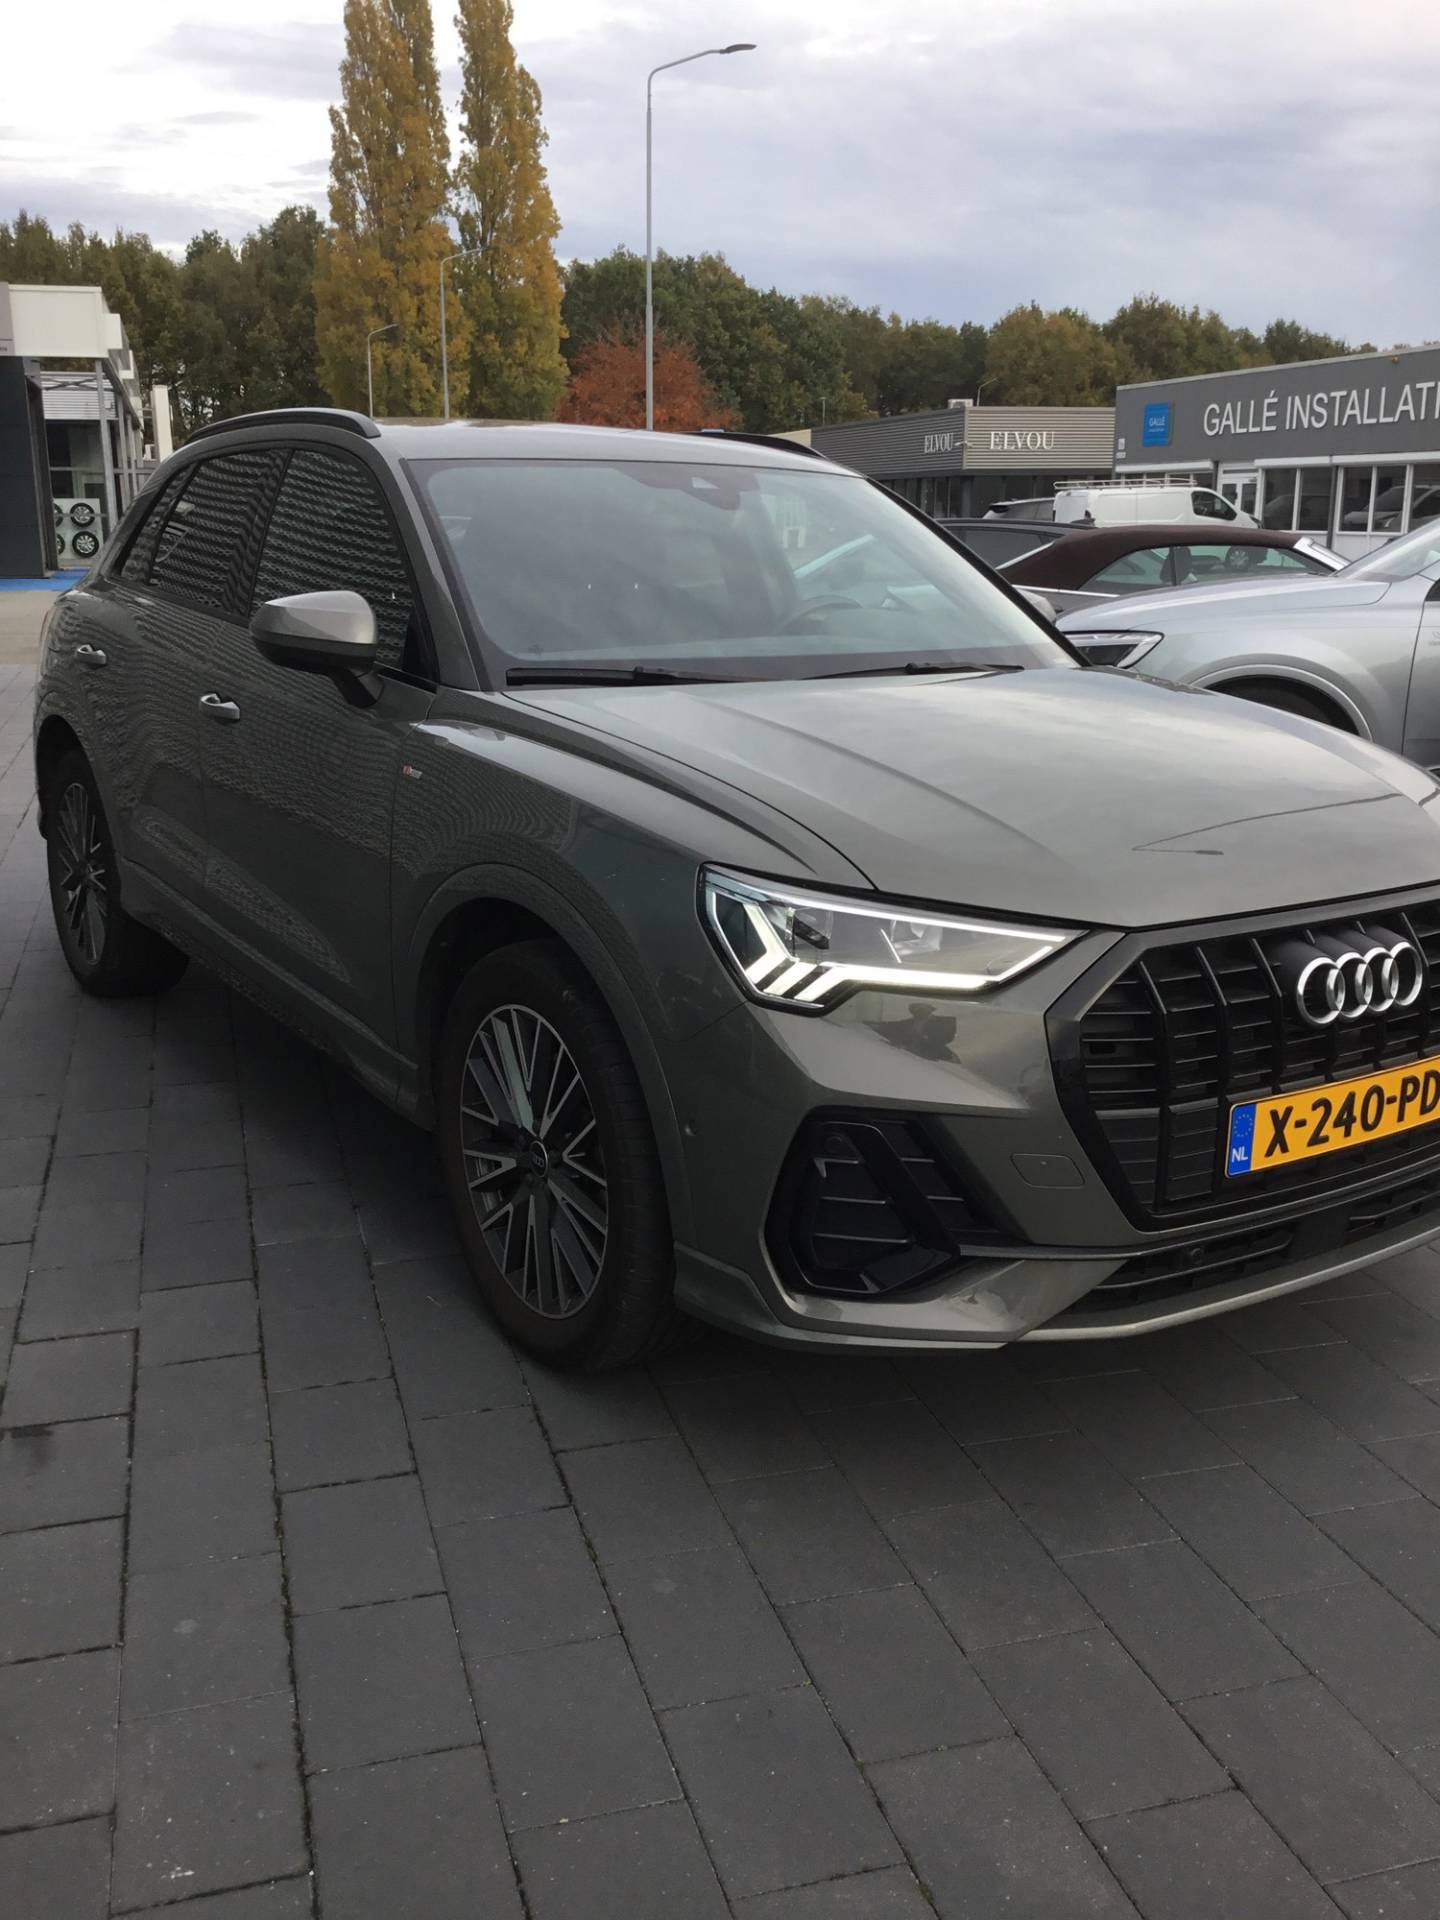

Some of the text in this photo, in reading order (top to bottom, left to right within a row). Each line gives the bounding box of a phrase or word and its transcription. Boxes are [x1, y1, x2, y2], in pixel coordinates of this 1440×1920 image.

[1203, 390, 1278, 436] GALLÉ
[924, 432, 954, 453] ELVOU
[989, 431, 1055, 450] ELVOU
[1264, 1069, 1440, 1158] X-240-PD
[1231, 1147, 1249, 1163] NL
